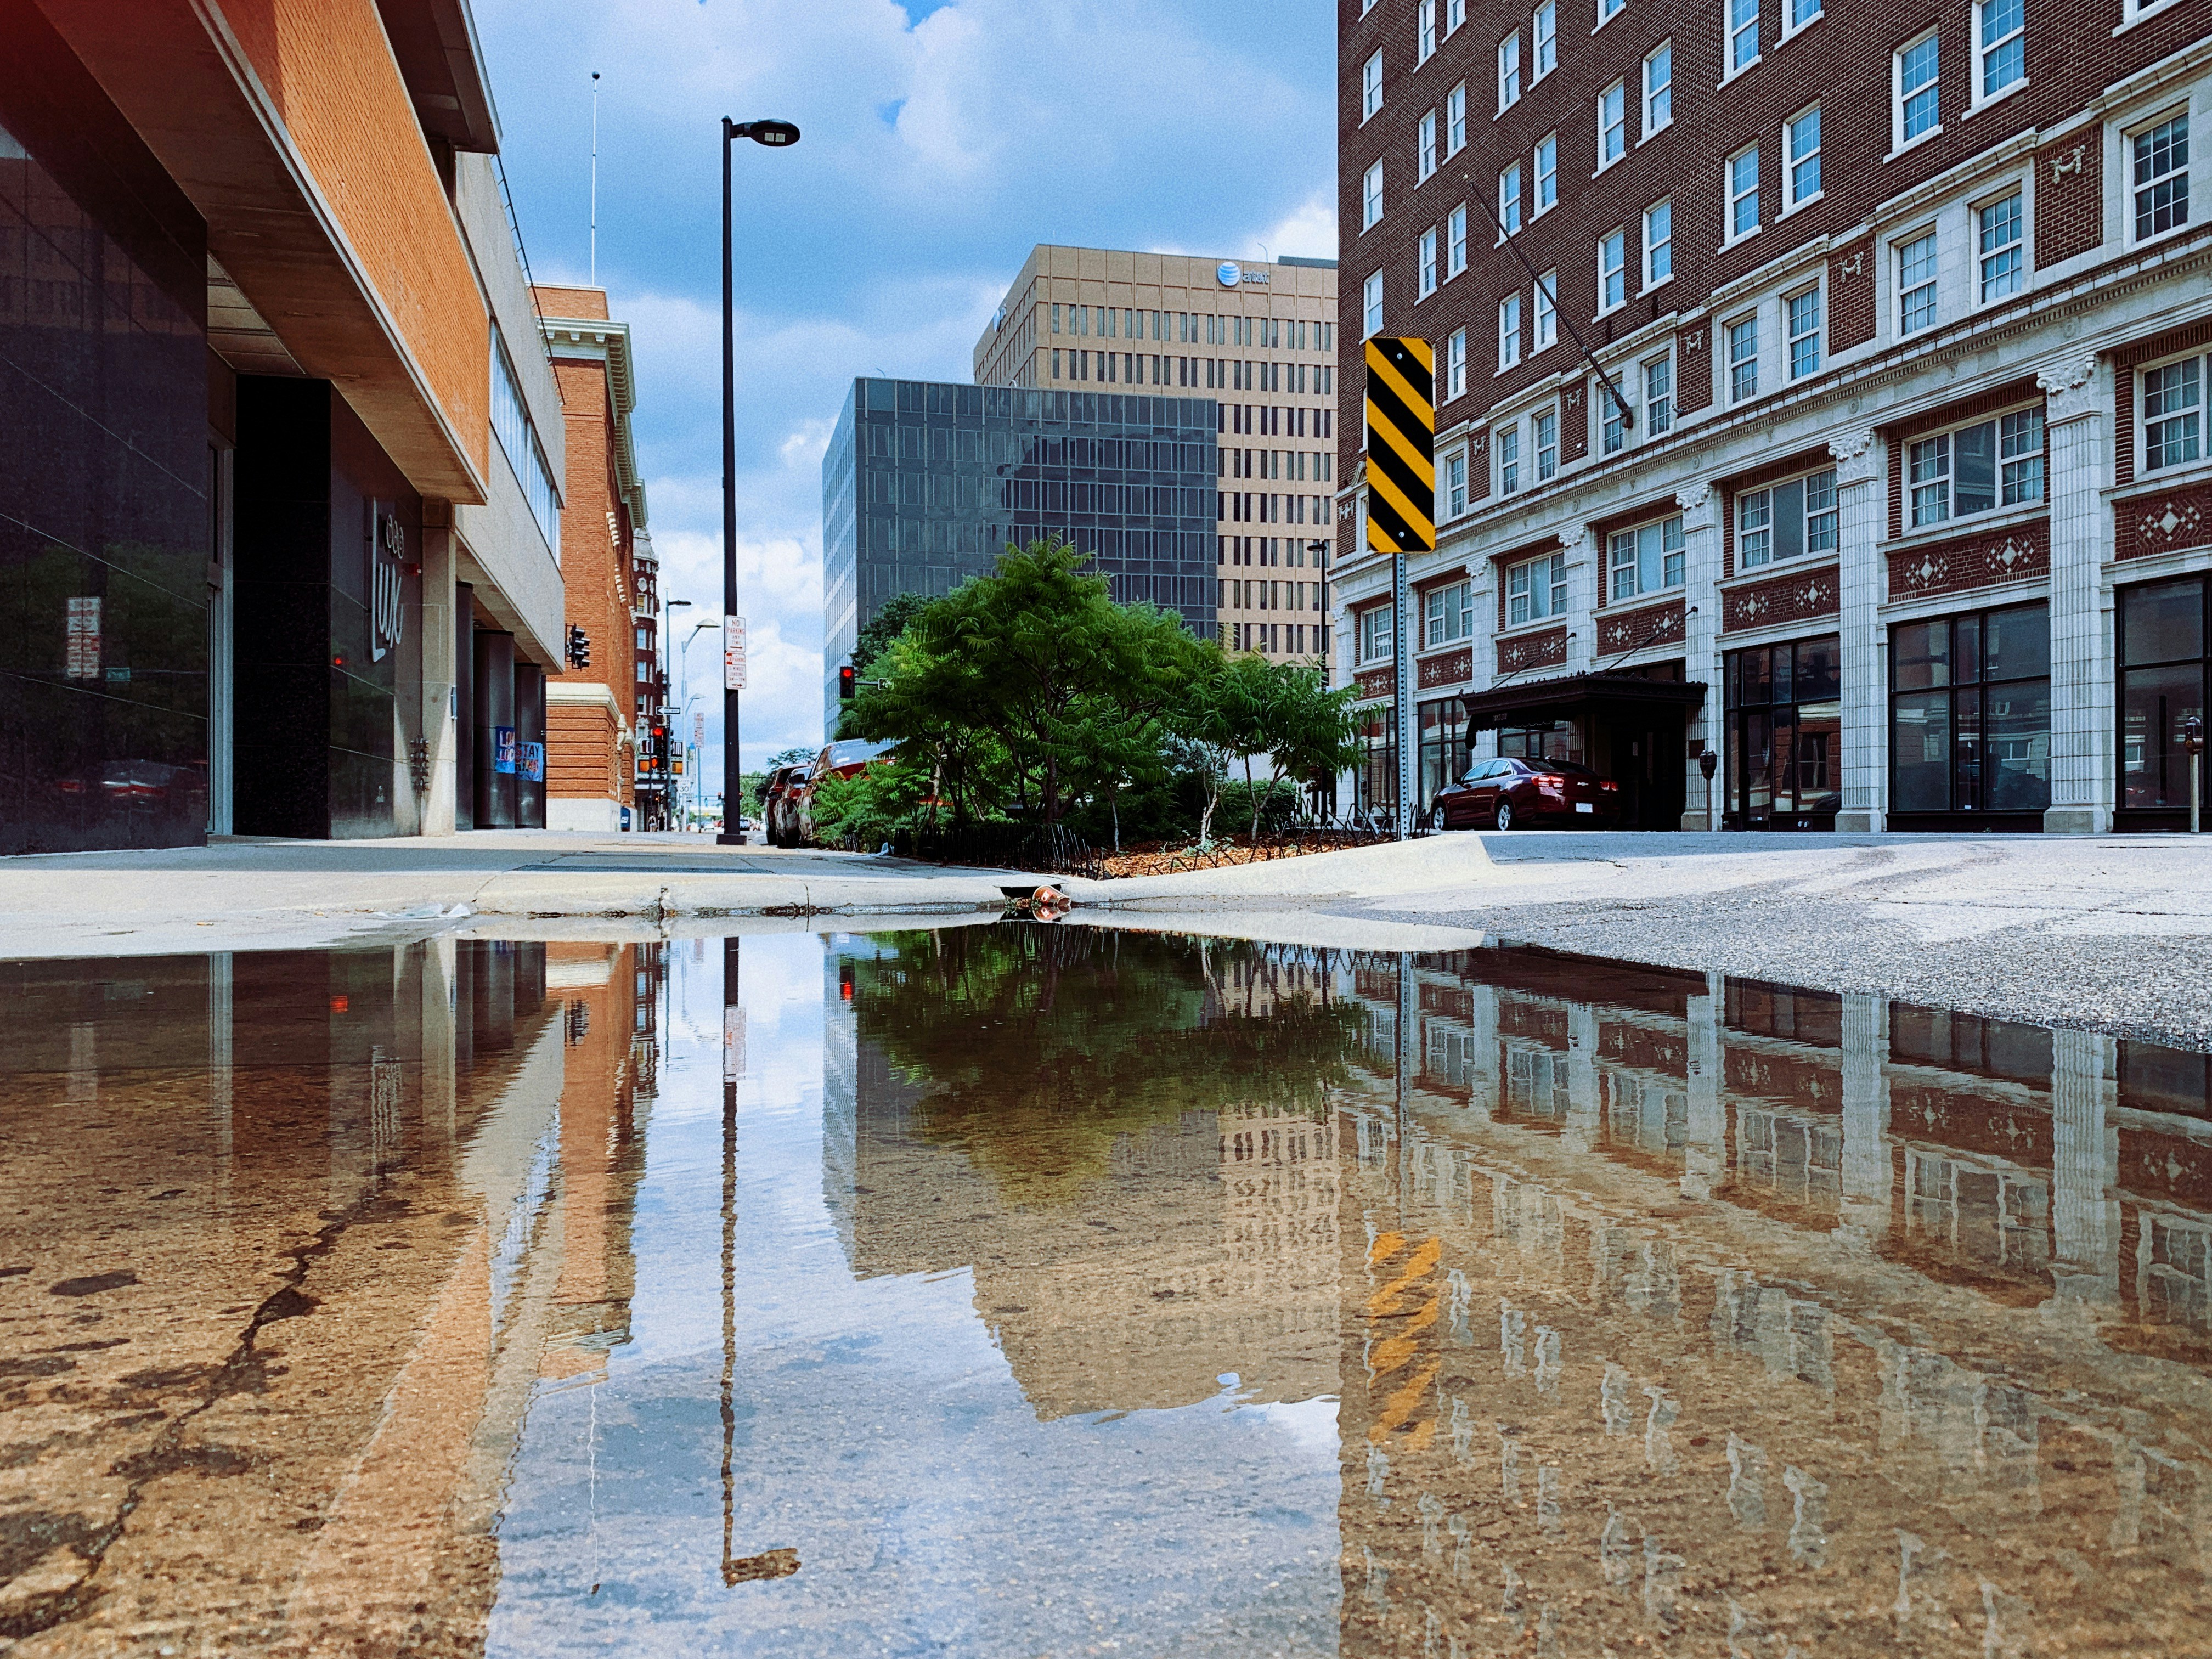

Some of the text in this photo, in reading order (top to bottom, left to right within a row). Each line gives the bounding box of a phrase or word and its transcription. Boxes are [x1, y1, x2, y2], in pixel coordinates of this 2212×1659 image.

[1243, 269, 1270, 284] at&t
[371, 496, 404, 662] Lux
[515, 743, 540, 758] STAY
